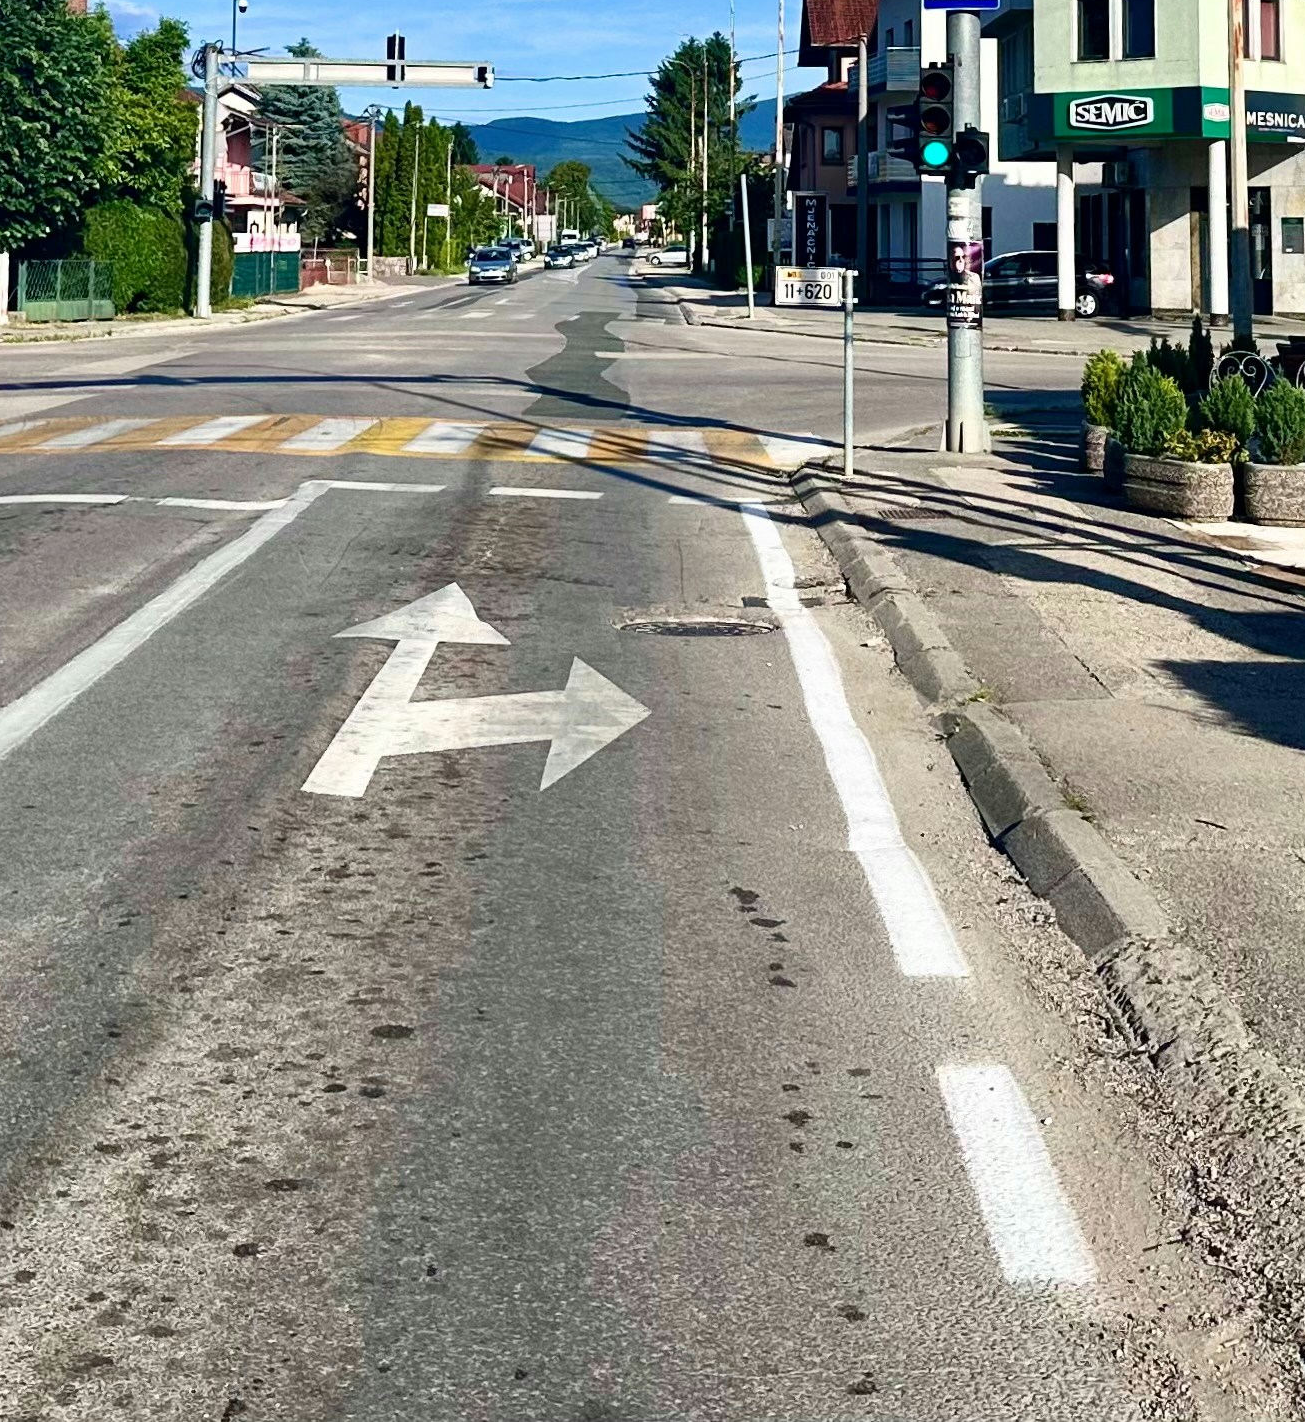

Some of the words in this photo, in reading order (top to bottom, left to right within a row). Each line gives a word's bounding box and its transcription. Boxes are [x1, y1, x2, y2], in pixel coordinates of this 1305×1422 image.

[1076, 100, 1146, 125] SEMIĆ
[1246, 111, 1305, 129] MESNICA
[785, 283, 832, 300] 11+620
